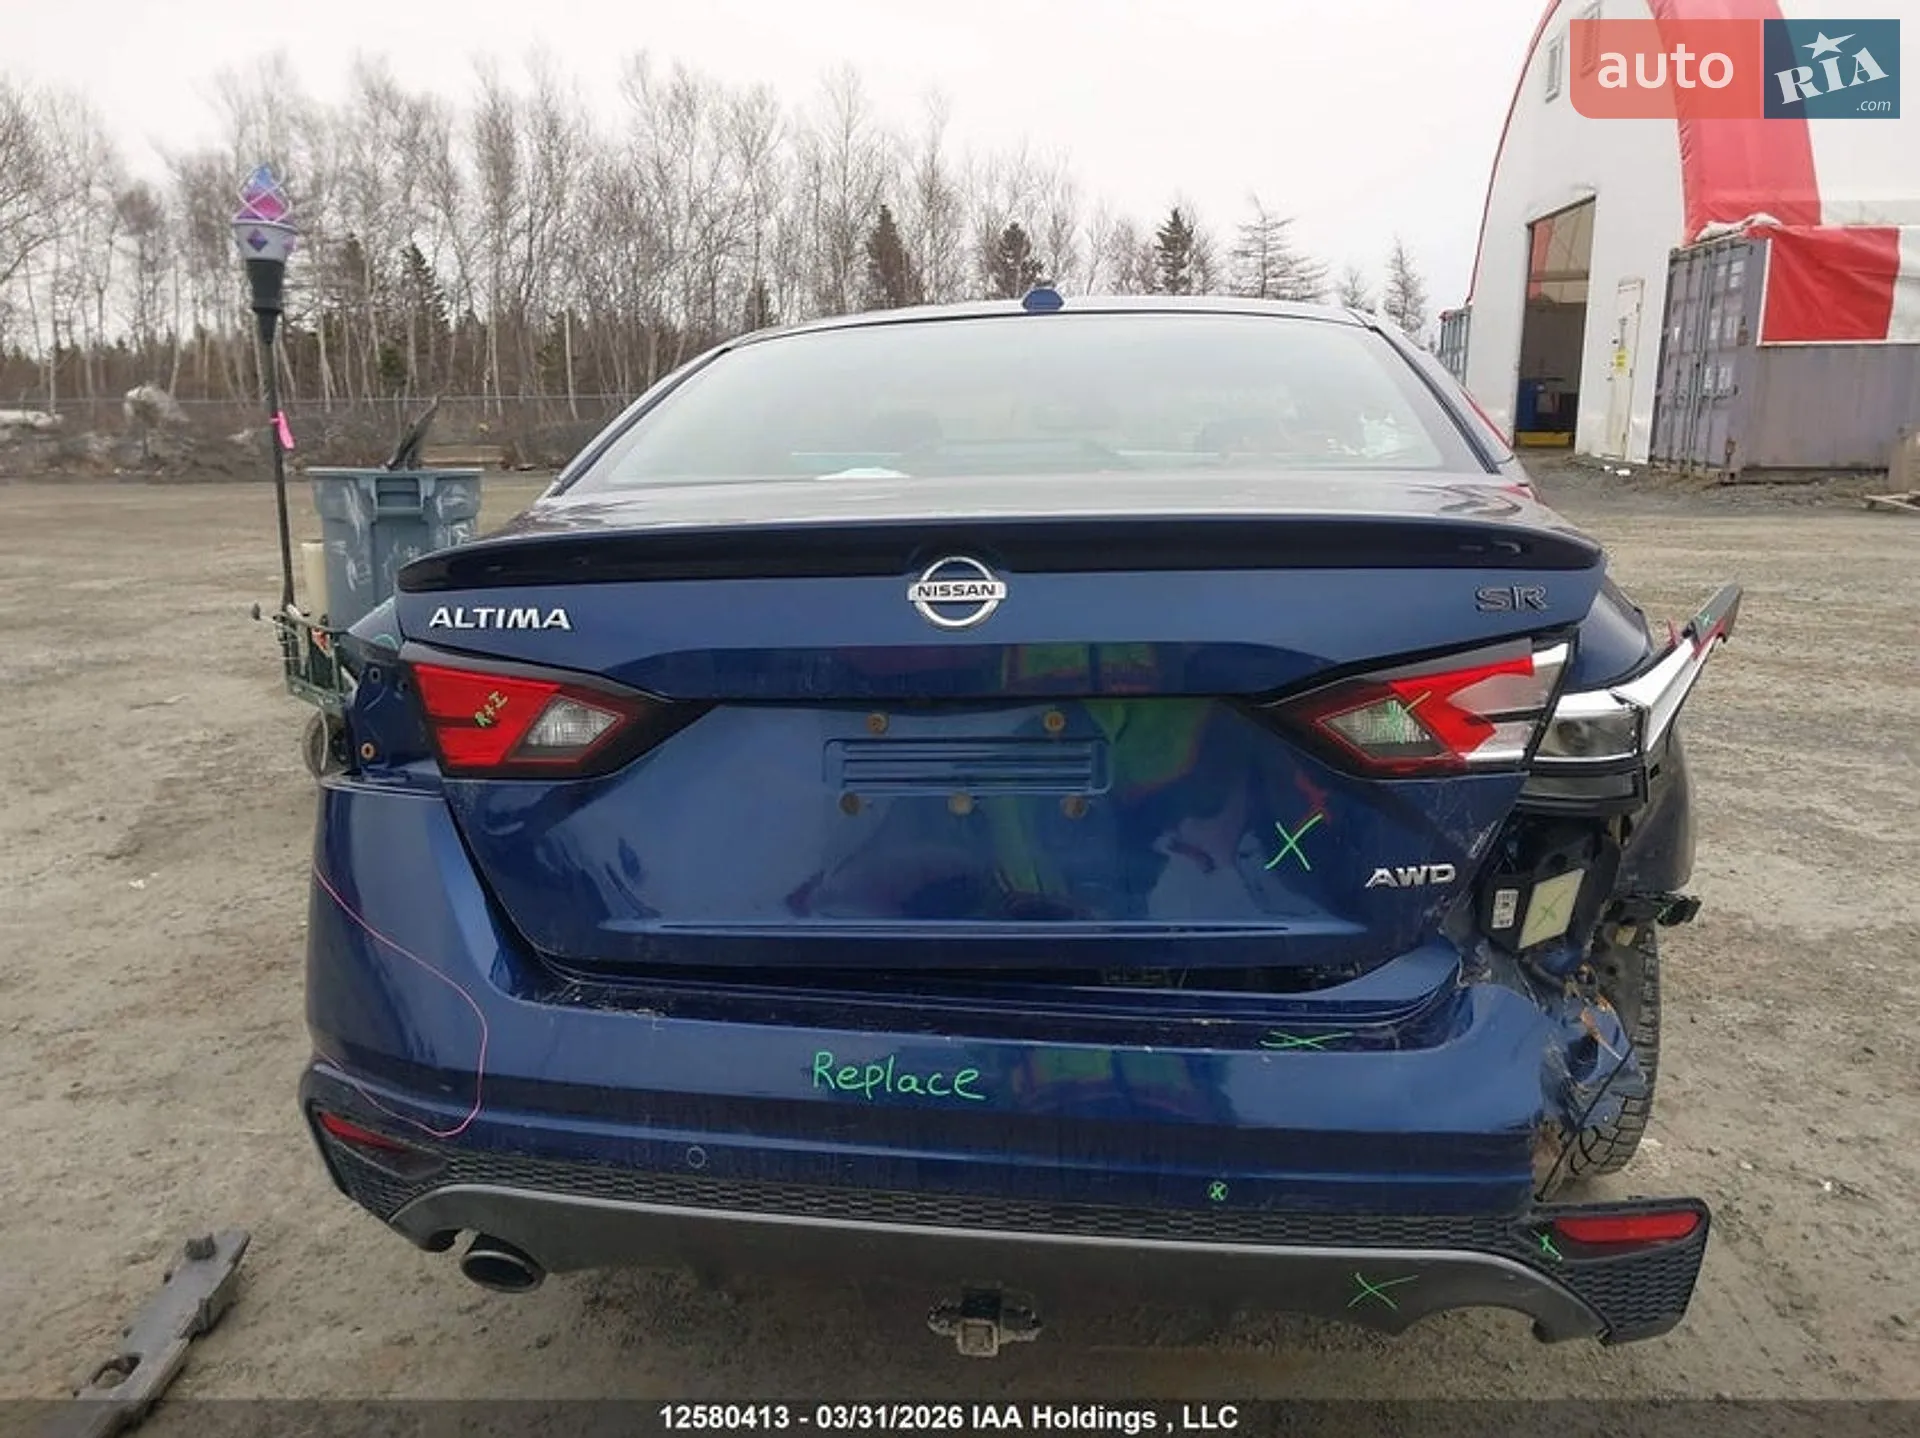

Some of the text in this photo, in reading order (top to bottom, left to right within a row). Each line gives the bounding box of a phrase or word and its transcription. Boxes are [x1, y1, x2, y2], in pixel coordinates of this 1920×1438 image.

[917, 583, 996, 597] NISSAN
[1475, 585, 1547, 612] SR
[428, 606, 572, 630] ALTIMA
[1364, 863, 1457, 888] AWD
[812, 1051, 986, 1100] Replace
